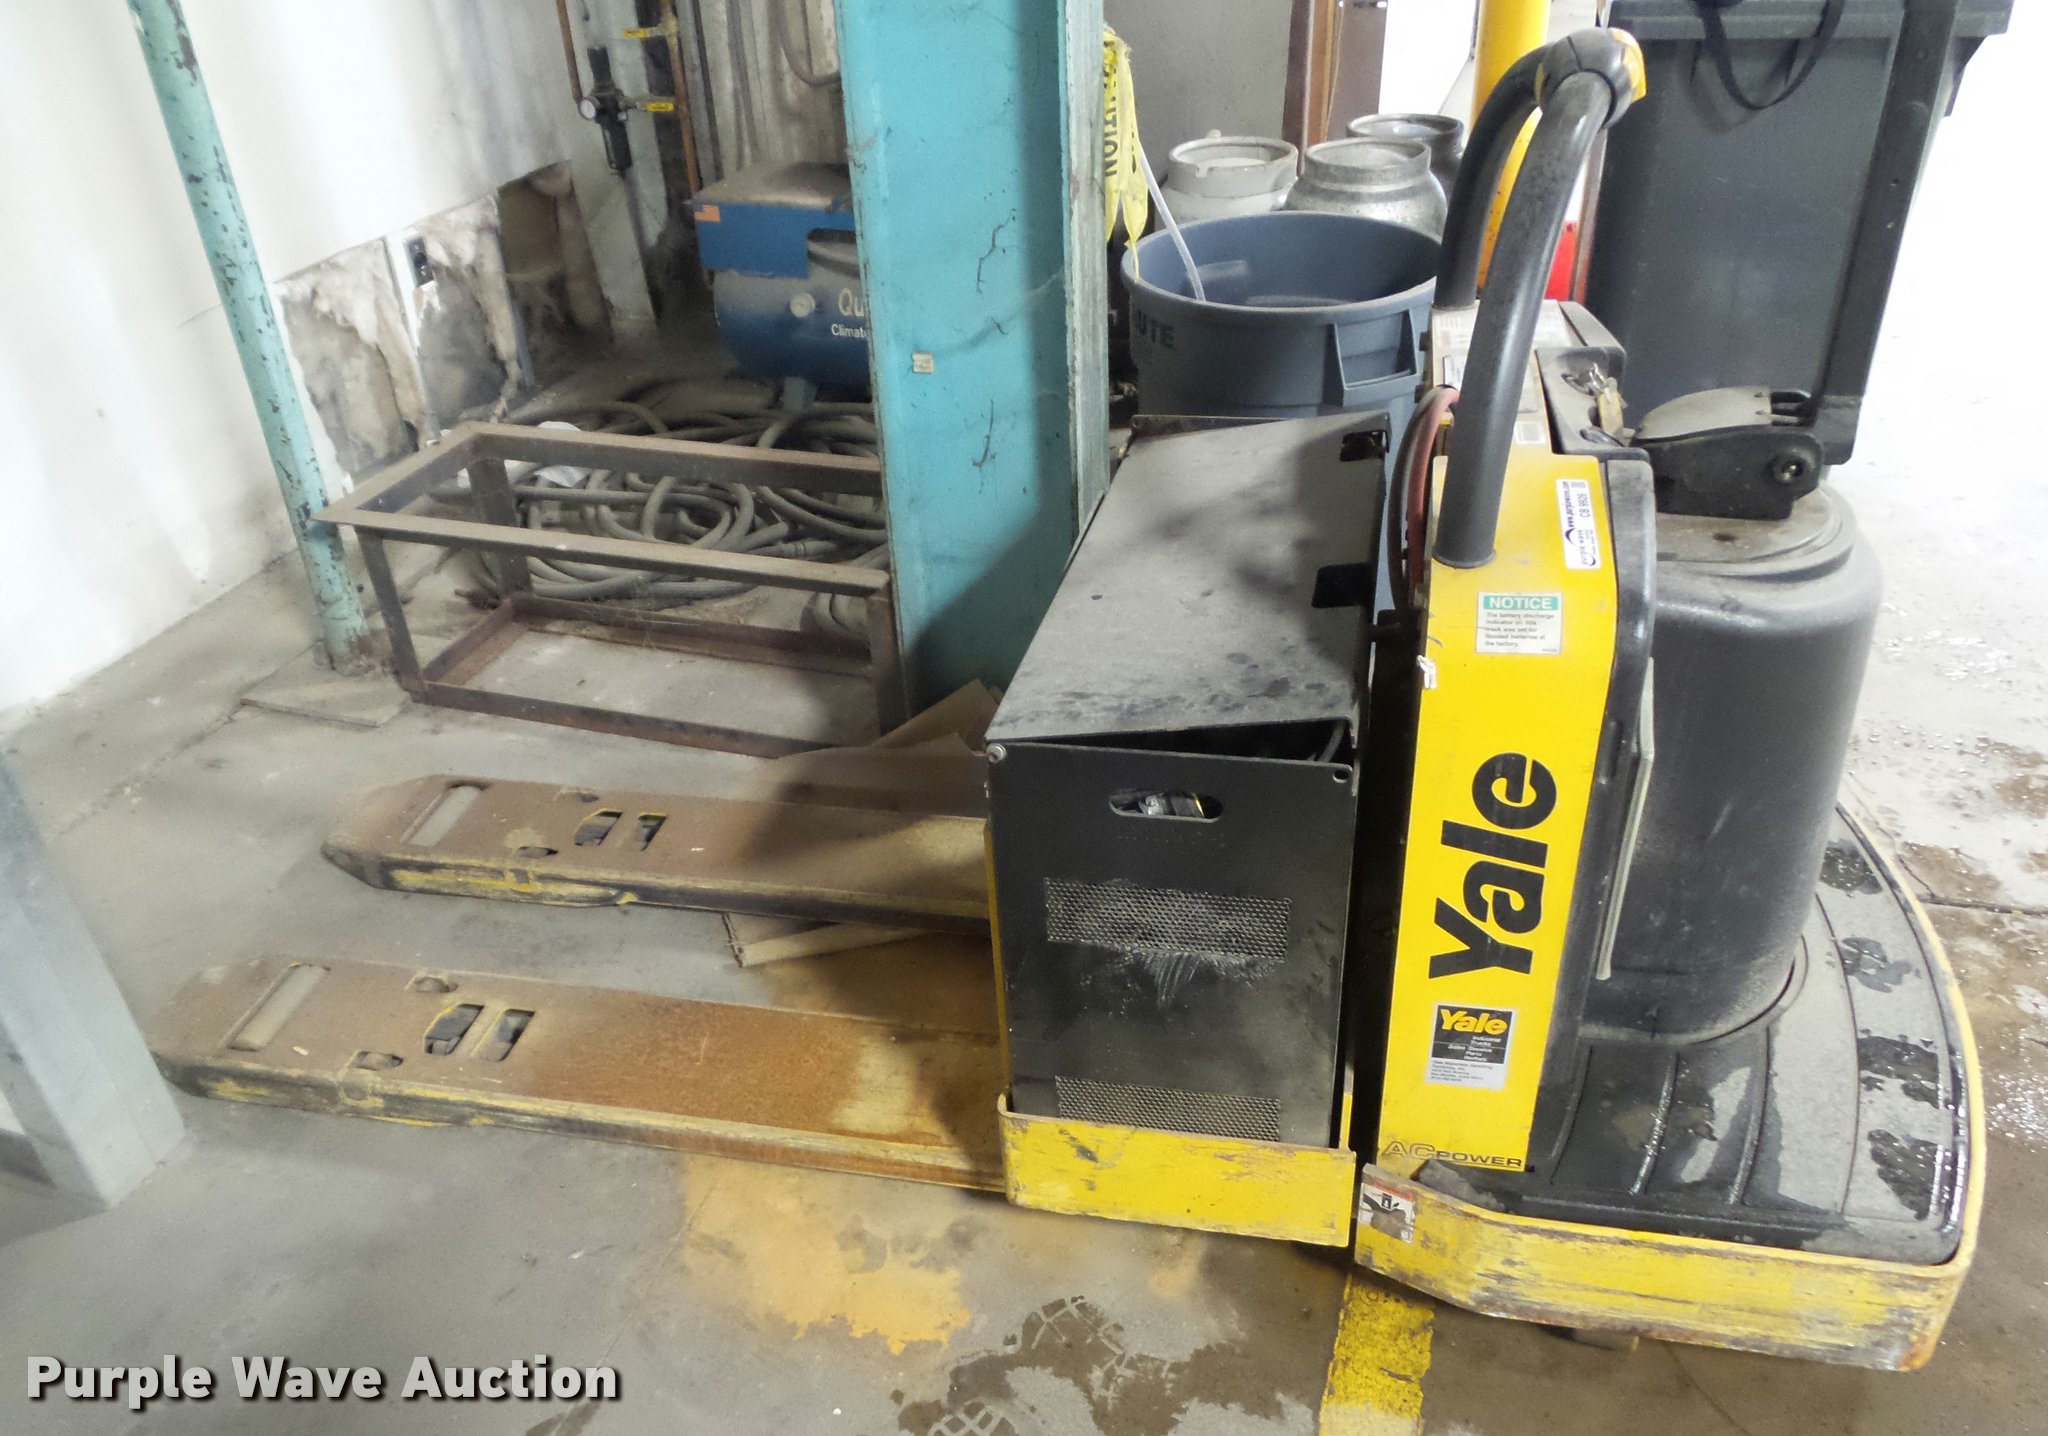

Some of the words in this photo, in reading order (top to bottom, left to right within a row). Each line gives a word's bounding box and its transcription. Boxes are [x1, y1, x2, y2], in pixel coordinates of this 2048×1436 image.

[1489, 597, 1552, 609] NOTICE
[1428, 752, 1557, 979] Yale
[1440, 1009, 1508, 1035] Yale
